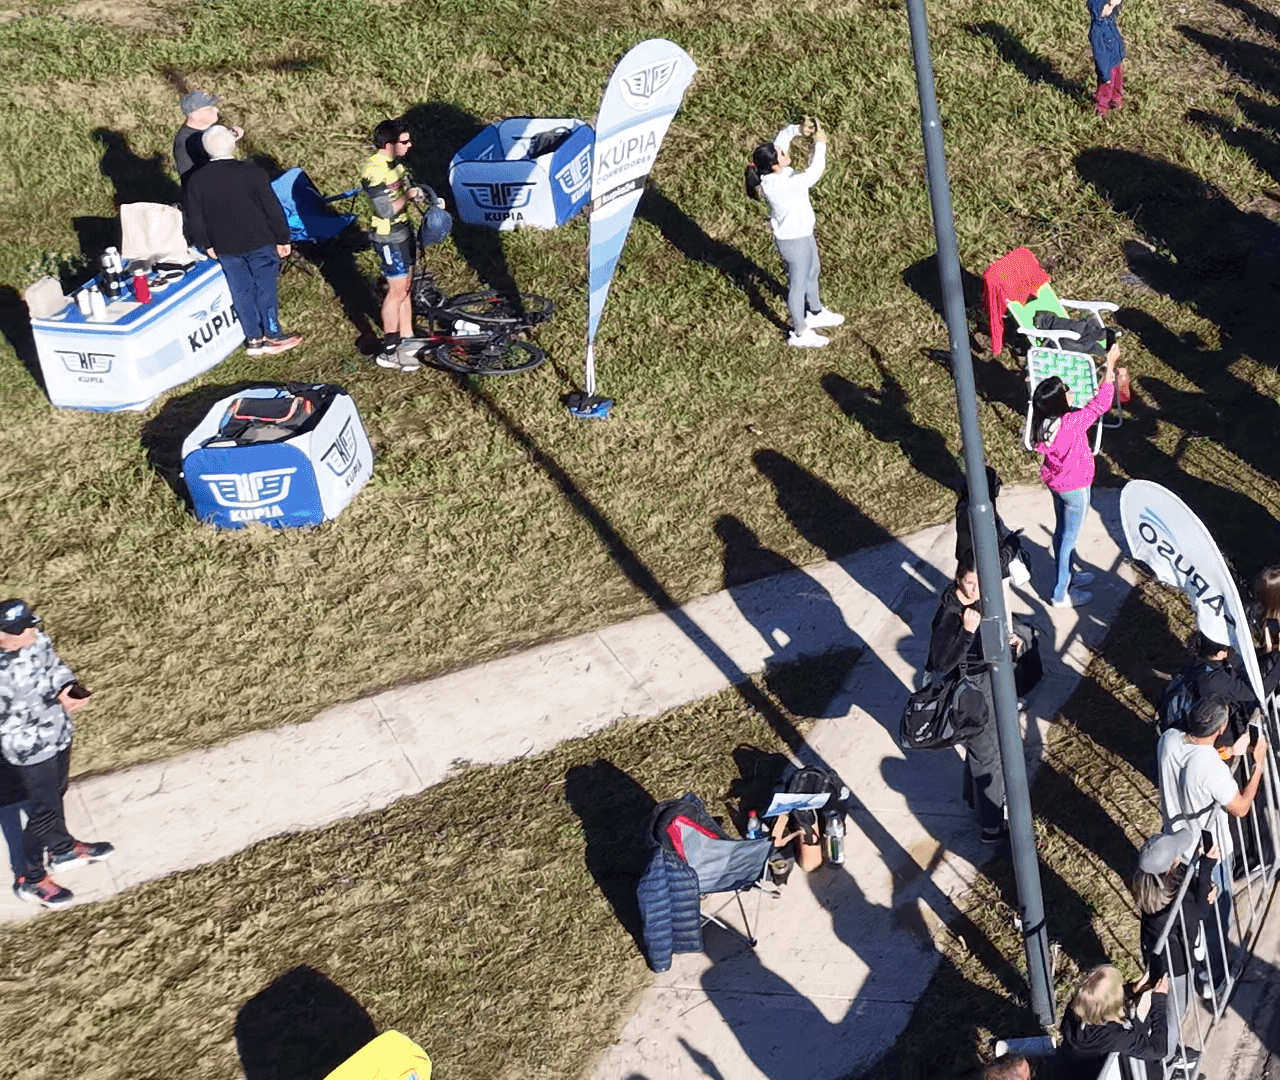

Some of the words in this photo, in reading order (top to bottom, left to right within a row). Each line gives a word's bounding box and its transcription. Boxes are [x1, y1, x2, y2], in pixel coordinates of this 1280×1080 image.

[484, 212, 524, 222] KUPIA
[187, 304, 240, 353] KUPIA
[229, 504, 285, 522] KUPIA
